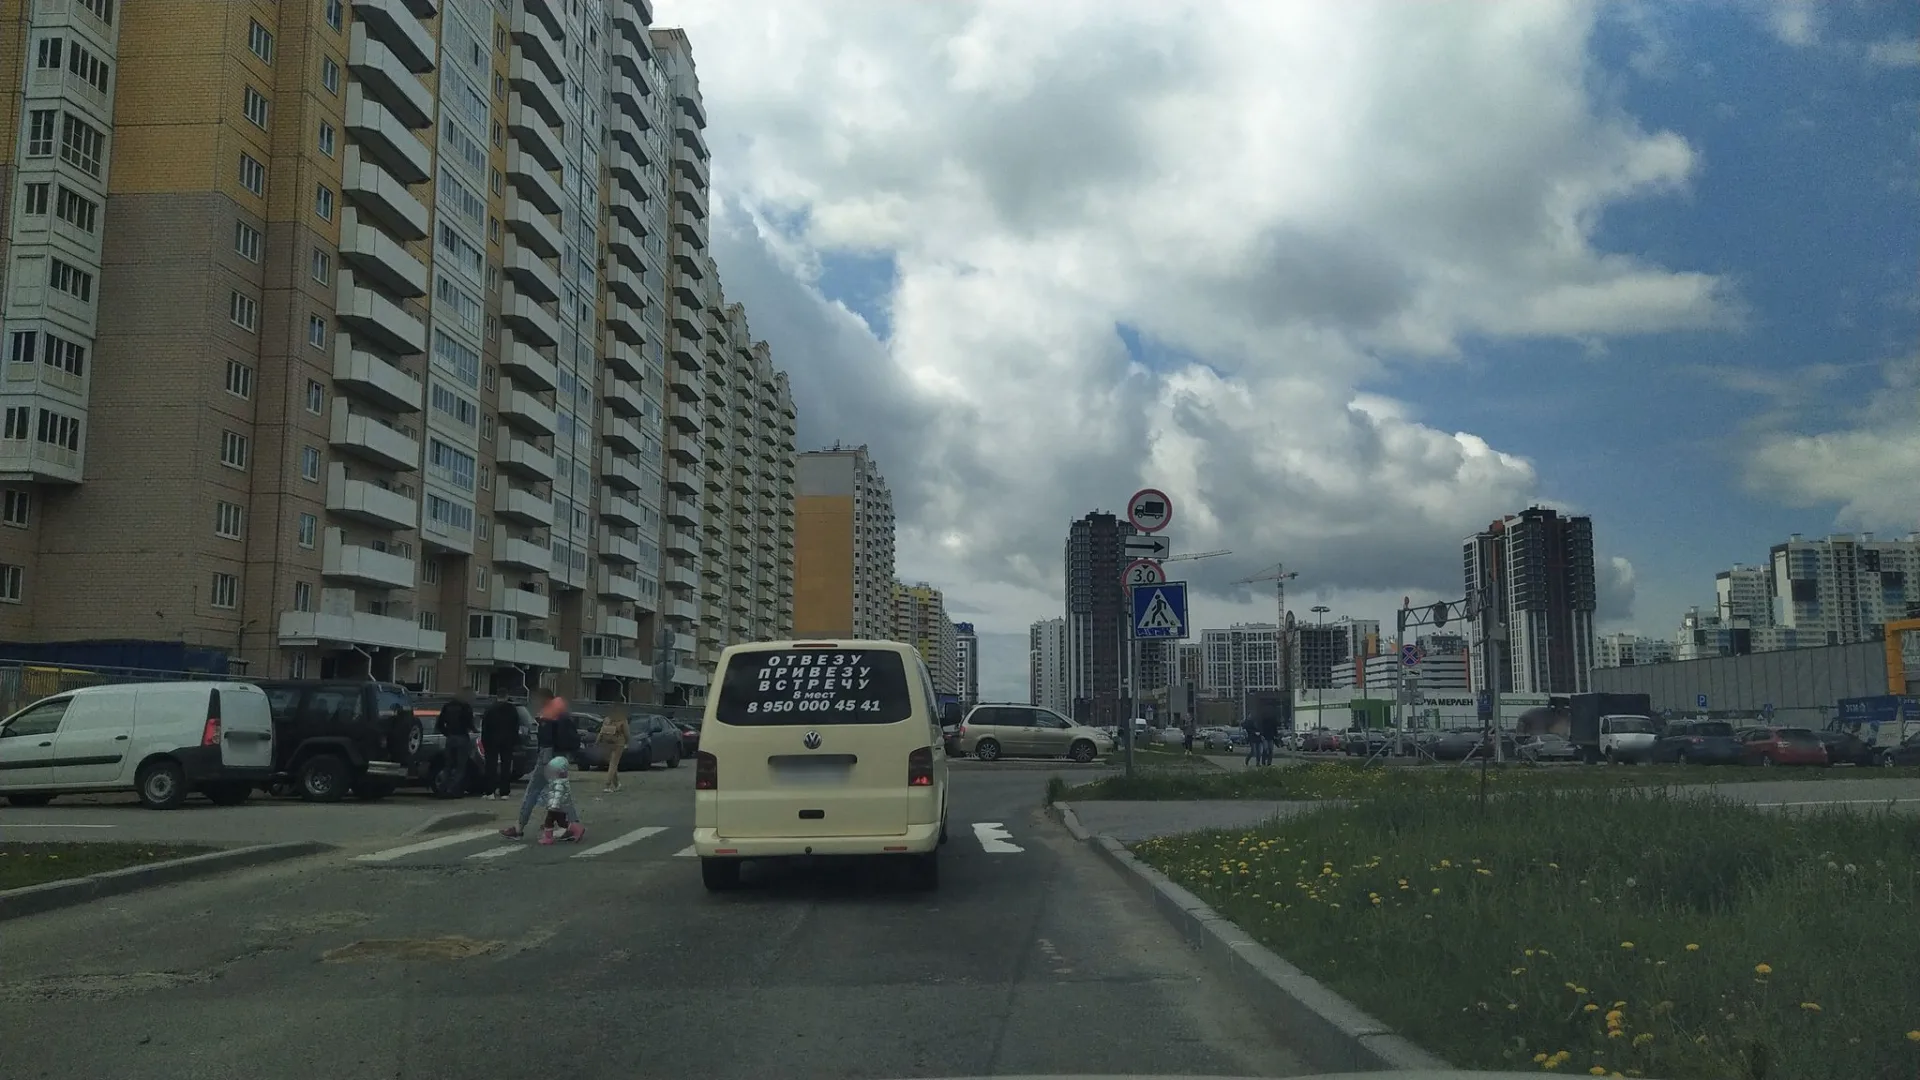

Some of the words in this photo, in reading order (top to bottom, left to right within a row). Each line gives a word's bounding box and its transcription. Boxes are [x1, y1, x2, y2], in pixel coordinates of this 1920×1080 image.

[768, 654, 862, 667] ОТВЕЗУ
[758, 666, 870, 679] ПРИВЕЗУ
[758, 679, 870, 691] ВСТРЕЧУ
[793, 691, 802, 699] 8
[804, 691, 837, 699] мест
[747, 702, 758, 713] 8
[762, 701, 794, 712] 950
[799, 700, 831, 711] 000
[835, 700, 856, 711] 45
[861, 700, 880, 711] 41
